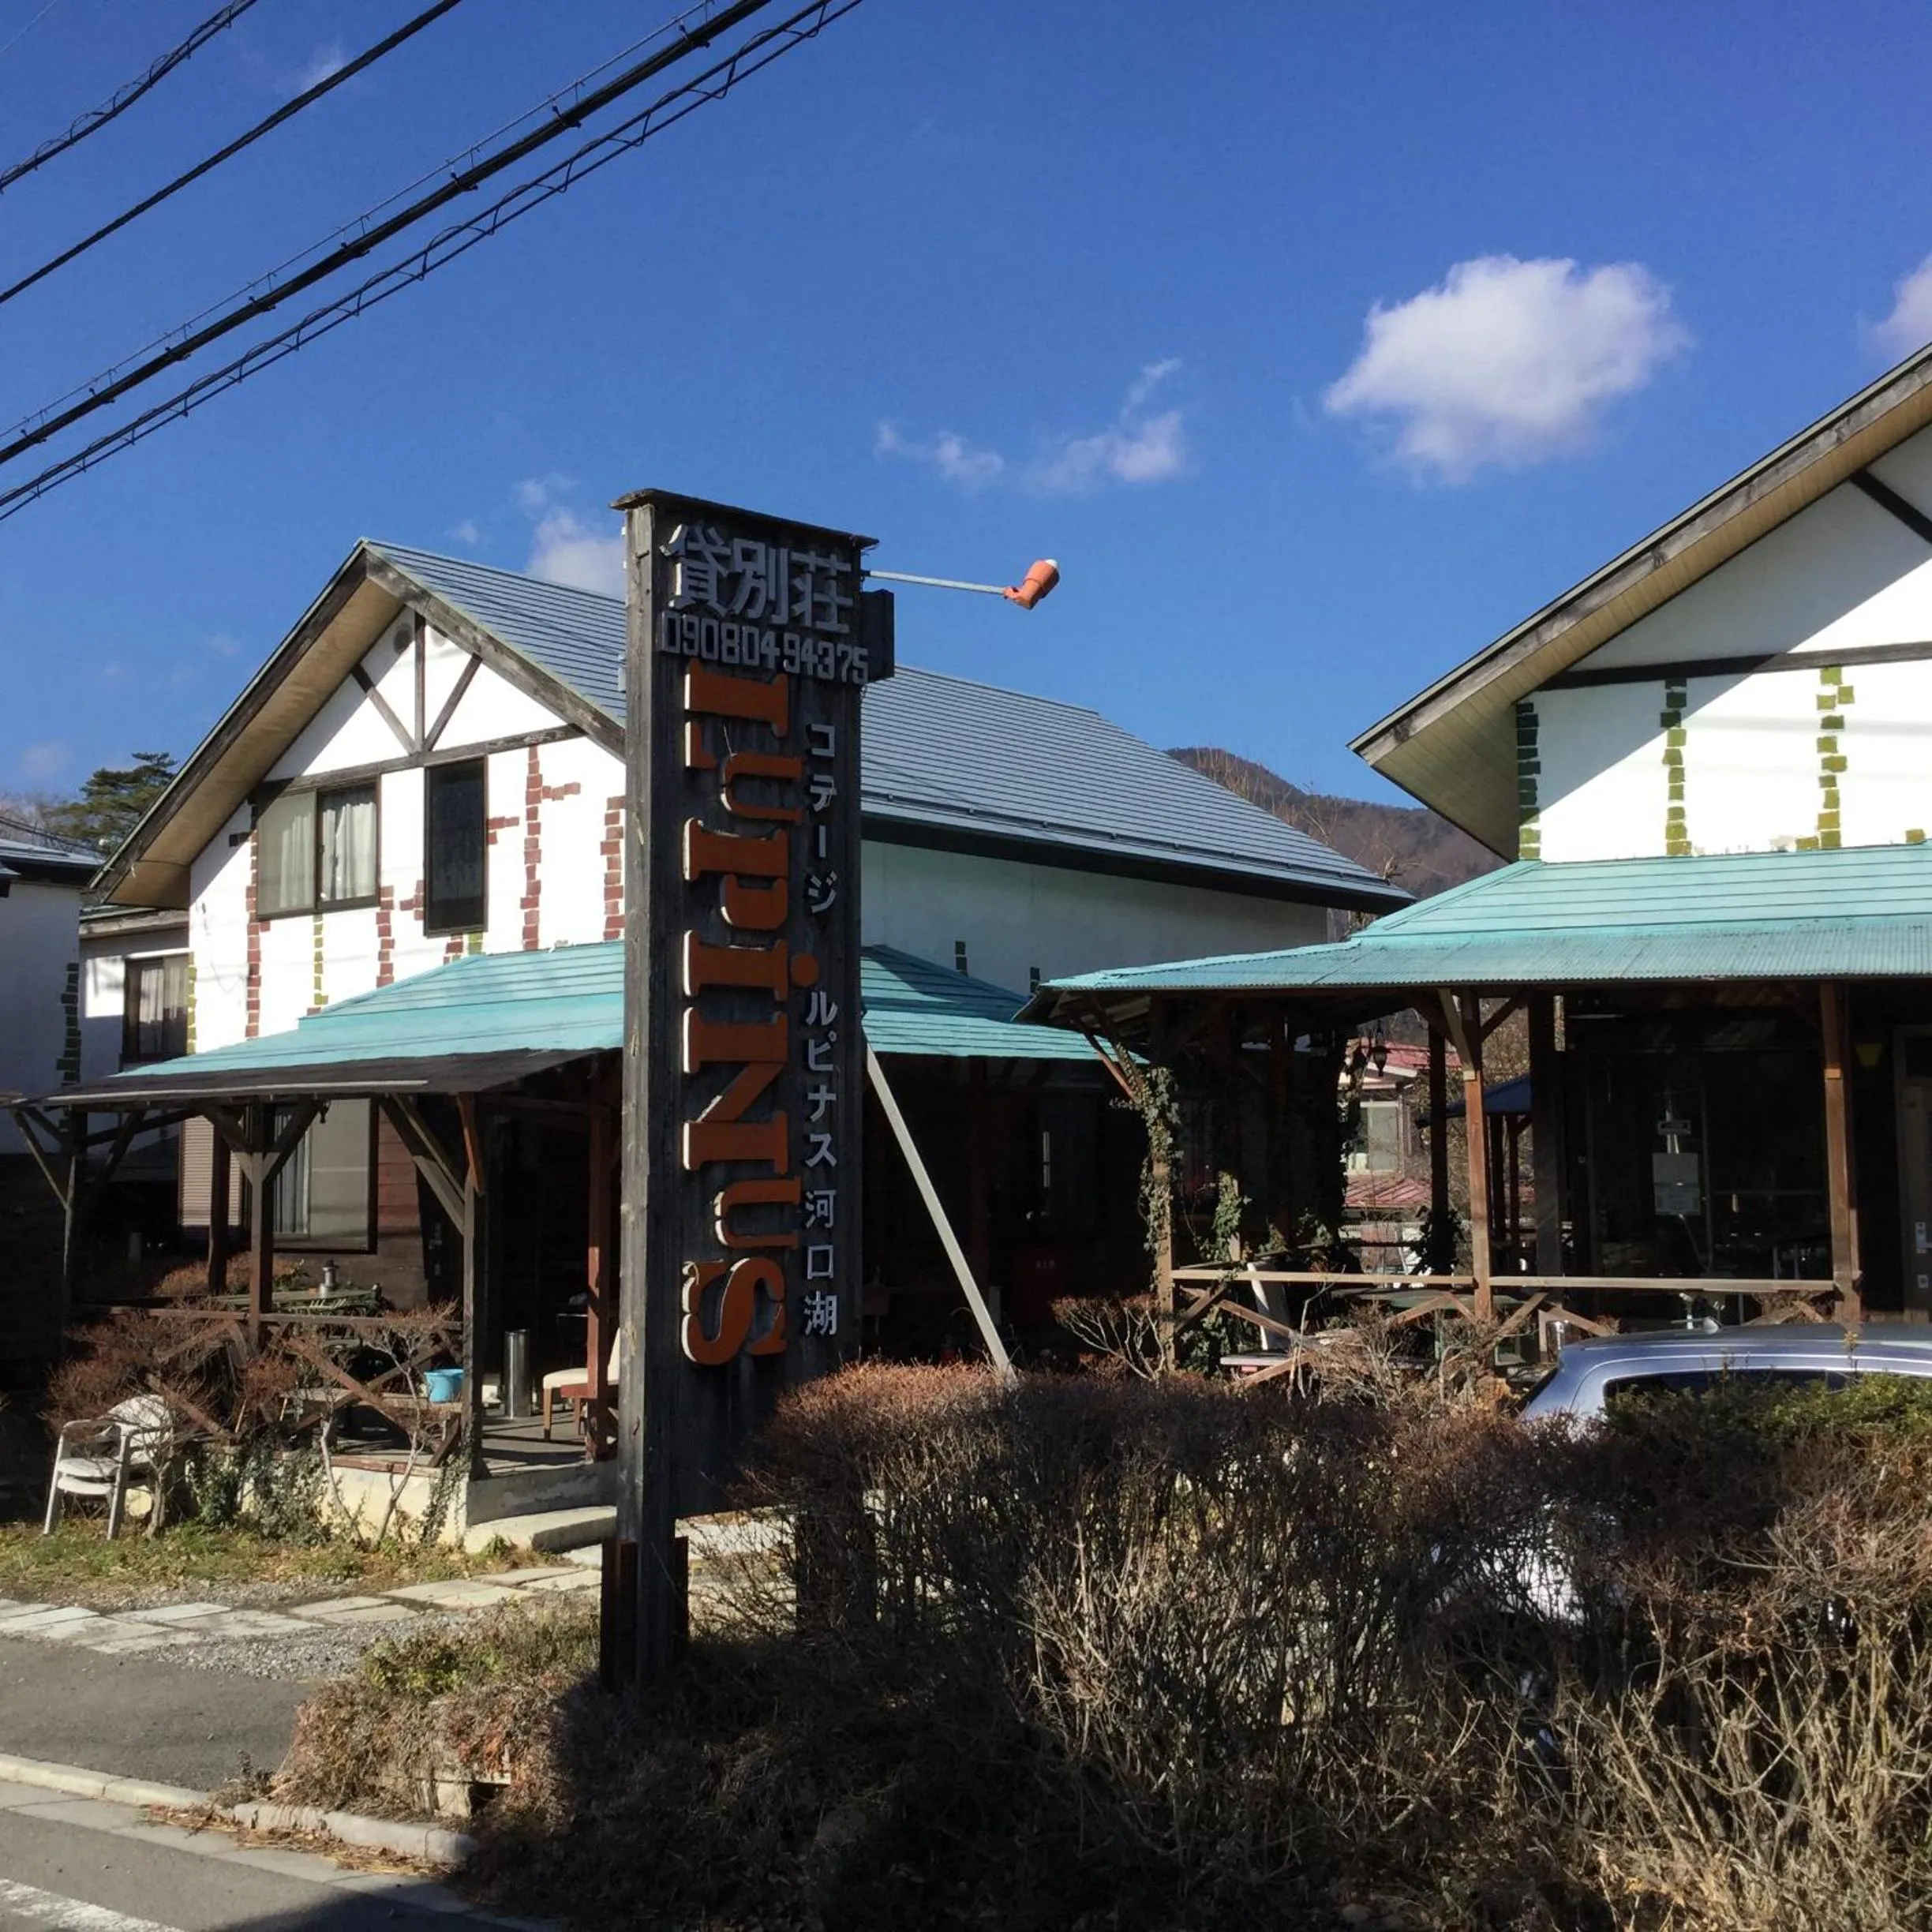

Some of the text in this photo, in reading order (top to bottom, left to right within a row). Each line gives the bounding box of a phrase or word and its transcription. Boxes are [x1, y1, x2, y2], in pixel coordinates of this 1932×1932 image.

[660, 523, 853, 634] 貸別荘
[661, 611, 869, 685] 09080494375
